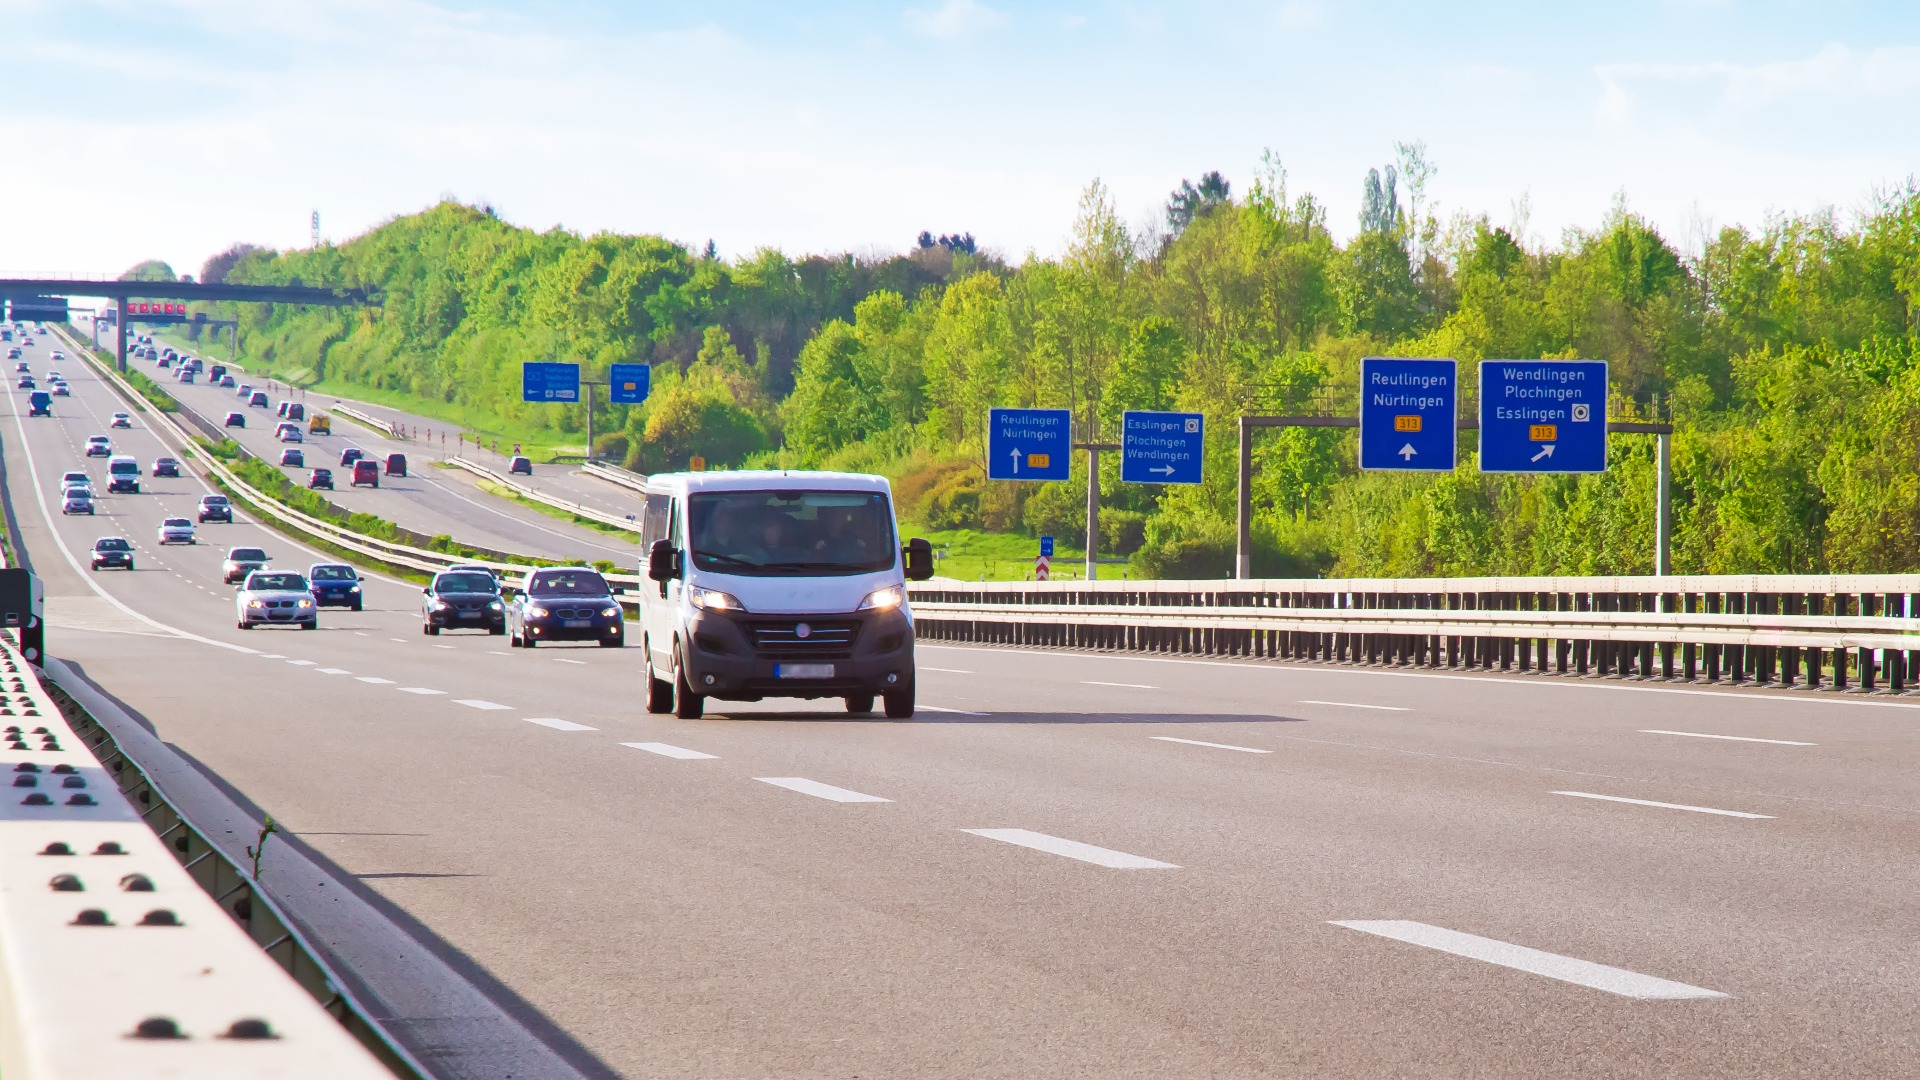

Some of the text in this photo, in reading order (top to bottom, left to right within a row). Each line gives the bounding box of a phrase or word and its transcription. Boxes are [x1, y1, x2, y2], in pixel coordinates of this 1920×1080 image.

[1371, 372, 1447, 389] Reutlingen
[1503, 367, 1585, 384] Wendlingen
[1505, 385, 1582, 402] Plochingen
[1373, 393, 1444, 410] Nürtingen
[1496, 406, 1565, 423] Esslingen
[1127, 419, 1180, 433] Esslingen
[1399, 418, 1418, 429] 313
[1534, 427, 1553, 438] 313
[1127, 435, 1186, 449] Plochingen
[1127, 449, 1190, 462] Wendlingen
